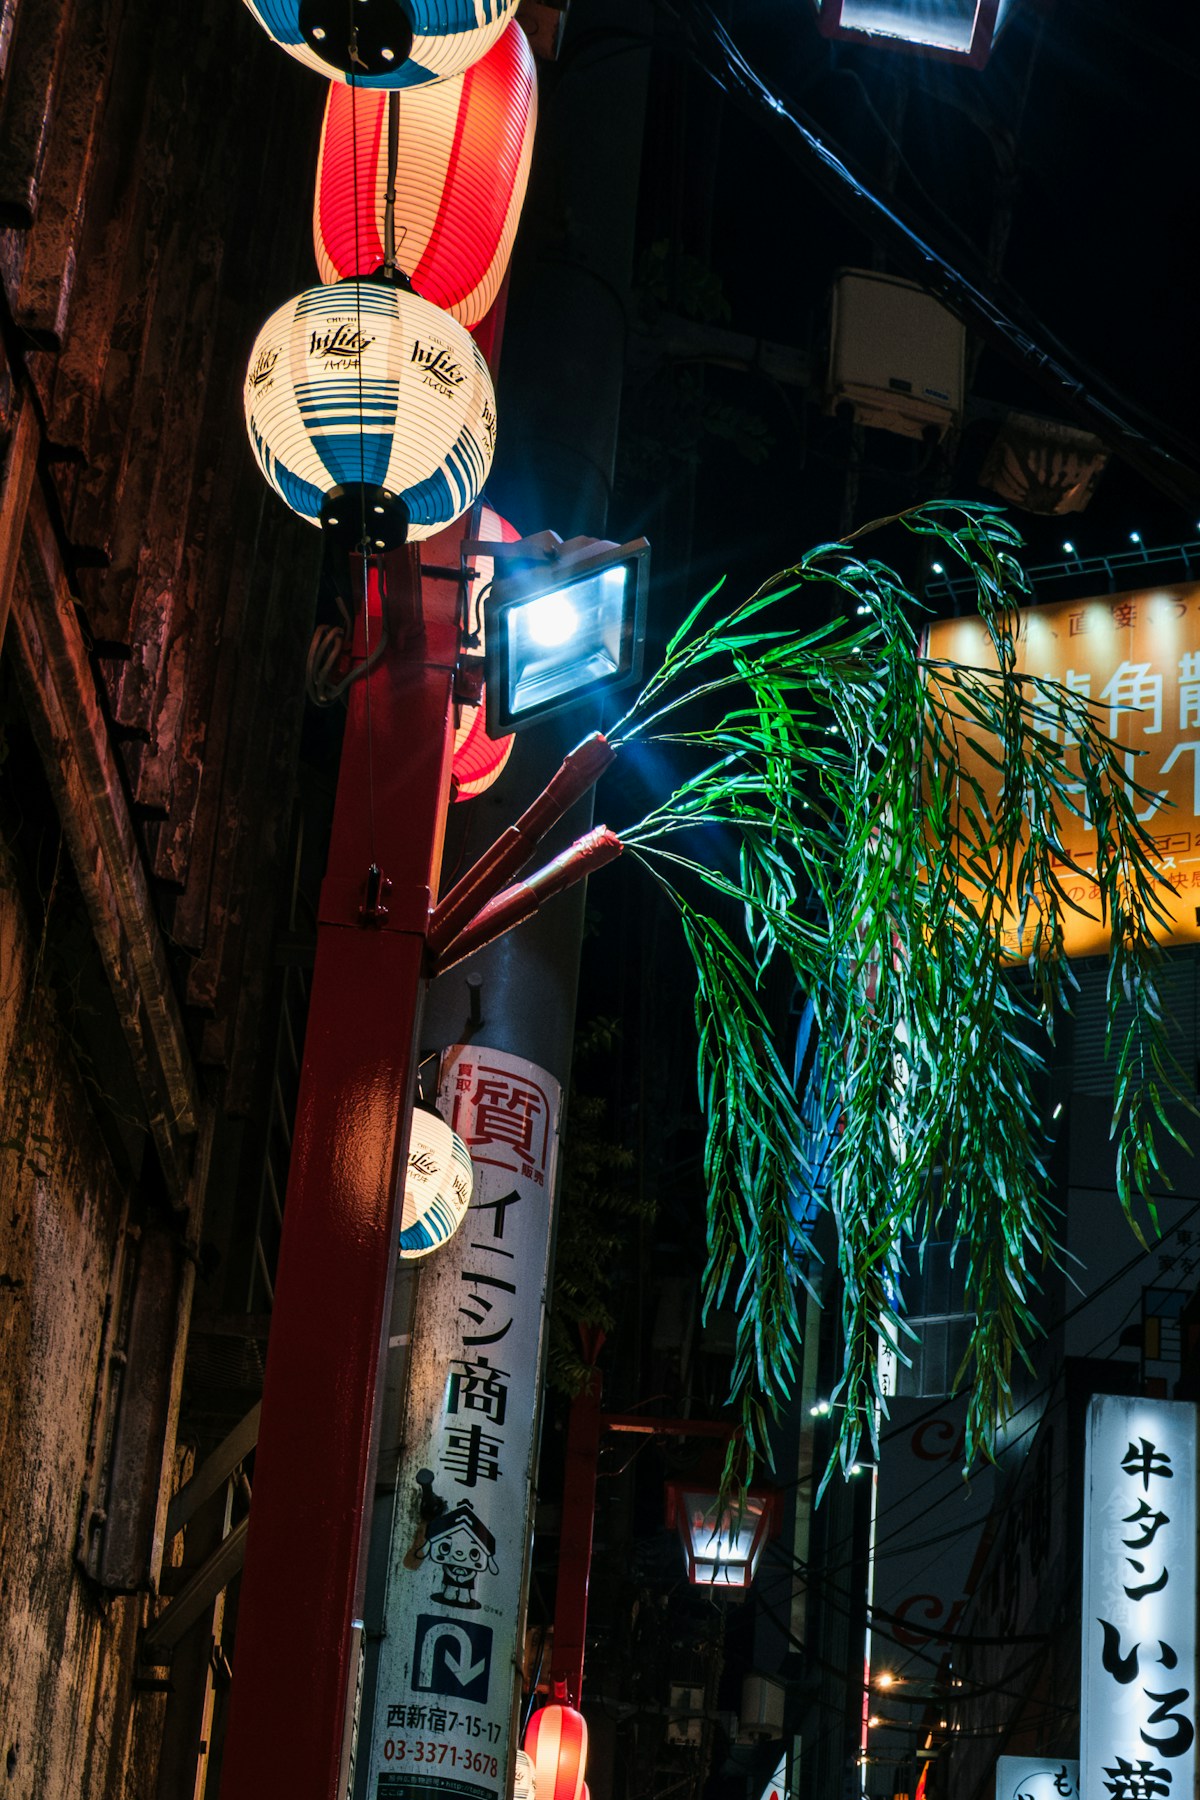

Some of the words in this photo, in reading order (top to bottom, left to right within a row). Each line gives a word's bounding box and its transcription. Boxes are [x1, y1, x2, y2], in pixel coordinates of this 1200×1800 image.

[466, 1078, 542, 1165] 質
[521, 1162, 546, 1188] 販売
[440, 1189, 521, 1489] イニシ商事
[1119, 1436, 1174, 1602] 牛タン
[386, 1703, 501, 1745] 西新宿7-15-17
[384, 1739, 498, 1778] 03-3371-3678
